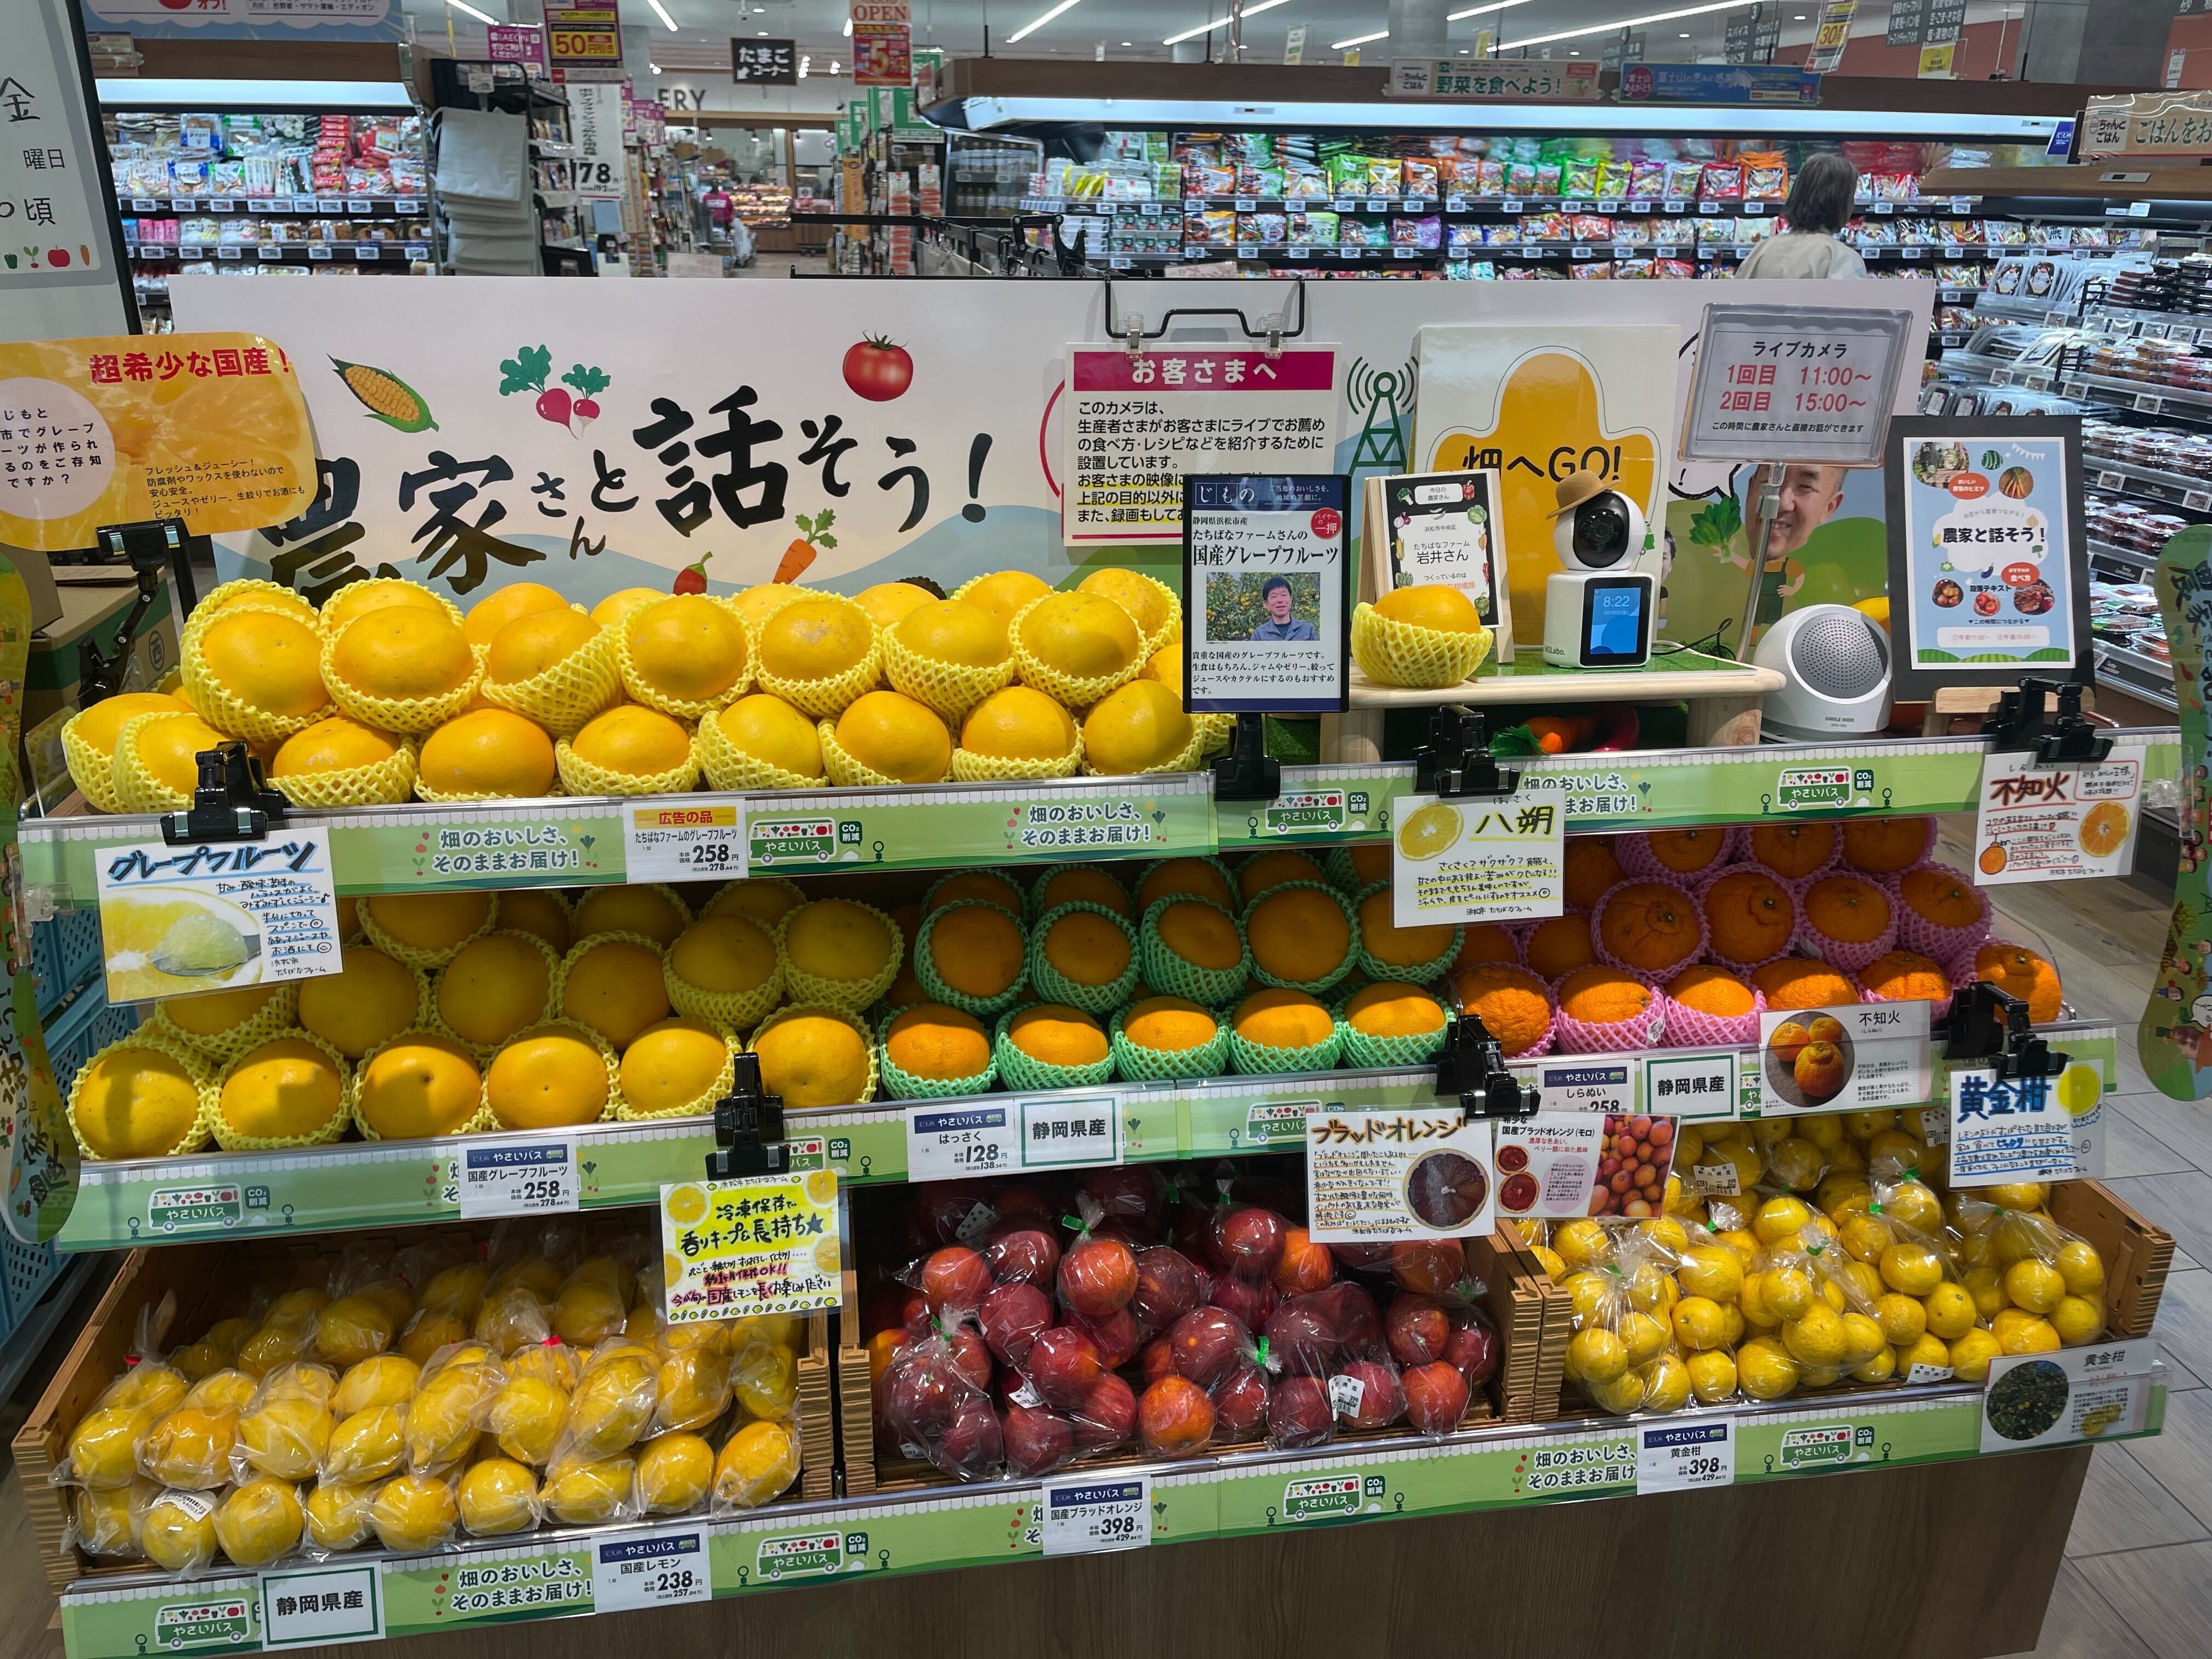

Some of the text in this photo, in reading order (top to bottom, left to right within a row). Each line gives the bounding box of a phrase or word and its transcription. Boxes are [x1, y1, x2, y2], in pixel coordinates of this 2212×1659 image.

[854, 5, 907, 21] OPEN
[556, 35, 585, 54] 50
[739, 47, 791, 64] たまご
[753, 65, 790, 76] コーナー
[1436, 75, 1561, 95] 野菜を食べよう！
[0, 77, 40, 122] 金
[2100, 117, 2126, 131] ちゃんと
[2096, 132, 2120, 144] ごはん
[23, 148, 65, 170] 曜日
[1753, 341, 1848, 359] ライブカメラ
[89, 347, 291, 383] 超希少な国産！
[1132, 358, 1277, 385] お客さまへ
[1728, 364, 1777, 386] 1回目
[1079, 400, 1165, 415] このカメラは、
[1719, 392, 1772, 411] 2回目
[4, 407, 48, 420] じもと
[1077, 417, 1325, 434] 生産者さまがお客さまにライブでお薦め
[5, 455, 101, 473] るのをご存知
[1077, 455, 1179, 470] 設置しています。
[8, 473, 70, 488] ですか？
[147, 466, 284, 487] 防腐剤やワックスを使わないので
[149, 486, 193, 498] 安心安全。
[1199, 486, 1256, 504] じもの
[1192, 516, 1248, 526] 静岡県浜松市産
[1192, 529, 1308, 540] たちばなファームさんの
[1943, 527, 2045, 544] 農家と話そう！
[1414, 540, 1470, 550] たちばなファーム
[1193, 544, 1339, 567] 国産グレープフルーツ
[1417, 549, 1469, 565] 岩井さん
[1424, 572, 1466, 581] つくっているのは
[1602, 596, 1630, 608] 8:22
[1192, 651, 1324, 660] 貴重な国産のグレープフルーツです。
[1192, 674, 1335, 684] ジュースやカクテルにするのもおすすめ
[1192, 686, 1212, 695] です。
[1792, 787, 1838, 798] やさいバス
[1990, 772, 2070, 805] 不知火
[1351, 803, 1367, 811] 削減
[1493, 794, 1531, 805] はっさく
[658, 810, 713, 826] 広告の品
[1029, 802, 1143, 824] 畑のおいしさ、
[1280, 810, 1331, 822] やさいバス
[1476, 806, 1554, 835] 八朔
[441, 824, 569, 851] 畑のおいしさ、
[635, 829, 737, 844] たちばなファームのグレープフルーツ
[842, 832, 860, 842] 削減
[1021, 825, 1151, 846] そのままお届け！
[765, 839, 821, 851] やさいバス
[109, 840, 317, 881] グレープフルーツ
[433, 849, 580, 874] そのままお届け！
[1859, 1010, 1901, 1026] 不知火
[1566, 1071, 1606, 1082] やさいバス
[1566, 1087, 1606, 1098] しらぬい
[1657, 1075, 1725, 1097] 静岡県産
[1957, 1075, 2052, 1124] 黄金柑
[938, 1116, 983, 1127] やさいバス
[1032, 1118, 1107, 1141] 静岡県産
[1311, 1118, 1468, 1144] ブラッドオレンジ
[939, 1131, 981, 1144] はっさく
[1528, 1137, 1568, 1146] 濃厚な色あい、
[493, 1151, 542, 1162] やさいバス
[830, 1149, 848, 1159] 削減
[468, 1166, 568, 1182] 国産グレープフルーツ
[249, 1197, 268, 1206] 削減
[716, 1194, 797, 1221] 冷凍保存で
[167, 1207, 226, 1220] やさいバス
[2084, 1349, 2126, 1367] 黄金柑
[1665, 1431, 1706, 1442] やさいバス
[1858, 1436, 1873, 1445] 削減
[1535, 1444, 1637, 1469] 畑のおいしさ、
[1671, 1446, 1701, 1458] 黄金柑
[1795, 1443, 1839, 1457] やさいバス
[1074, 1488, 1119, 1500] やさいバス
[1367, 1486, 1384, 1495] 削減
[1298, 1495, 1348, 1509] やさいバス
[1051, 1502, 1143, 1521] 国産ブラッドオレンジ
[625, 1542, 674, 1556] やさいバス
[848, 1543, 866, 1554] 削減
[620, 1558, 680, 1575] 国産レモン
[773, 1555, 828, 1568] やさいバス
[459, 1564, 583, 1589] 畑のおいしさ、
[276, 1591, 364, 1615] 静岡県産
[451, 1582, 592, 1610] そのままお届け！
[173, 1622, 233, 1637] やさいバス
